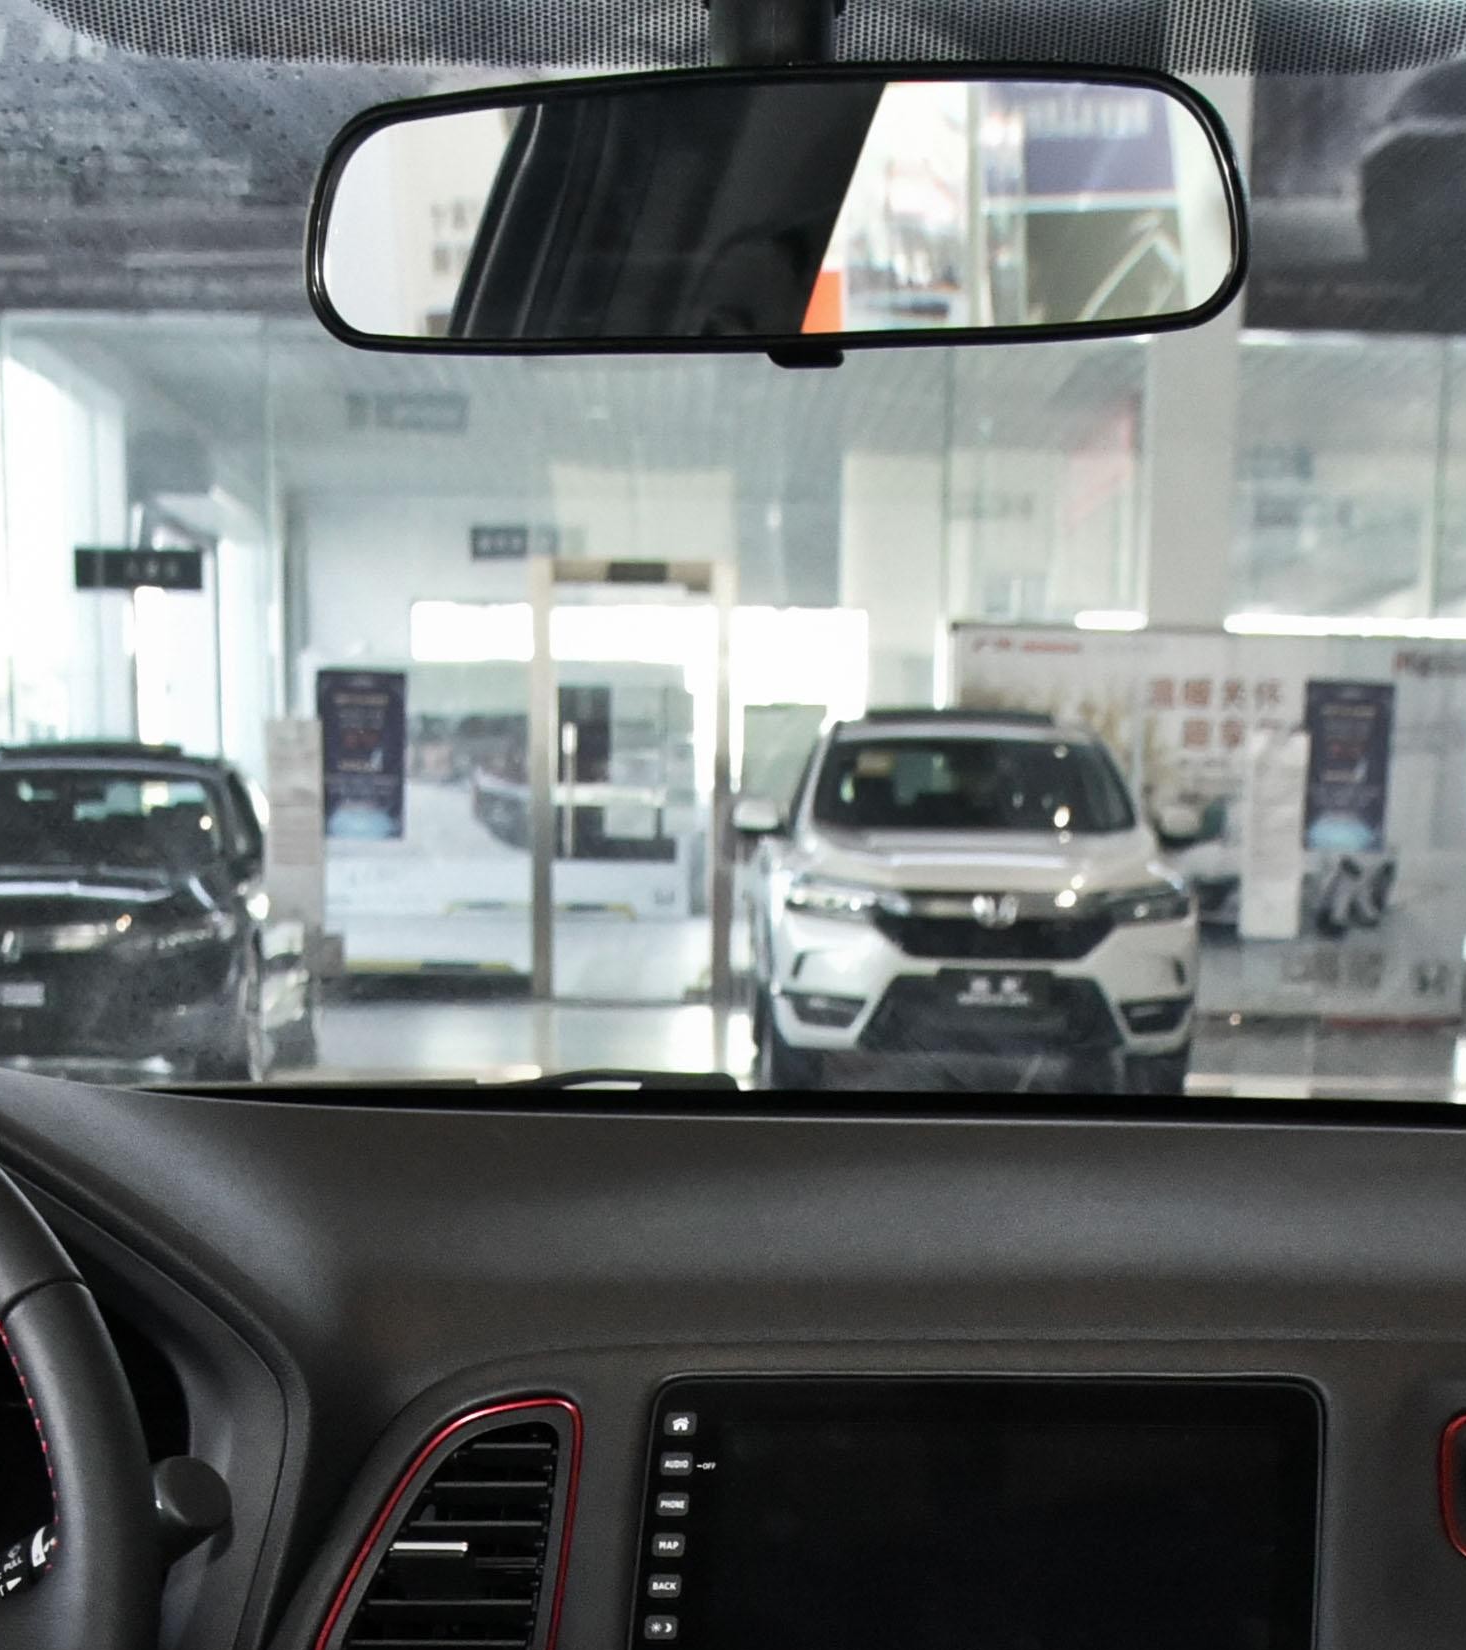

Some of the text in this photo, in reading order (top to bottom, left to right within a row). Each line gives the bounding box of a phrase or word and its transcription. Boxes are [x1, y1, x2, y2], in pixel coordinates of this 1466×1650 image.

[663, 1459, 690, 1470] AUDIO
[659, 1499, 686, 1510] PHONE
[658, 1541, 680, 1551] MAP
[651, 1581, 678, 1591] BACK
